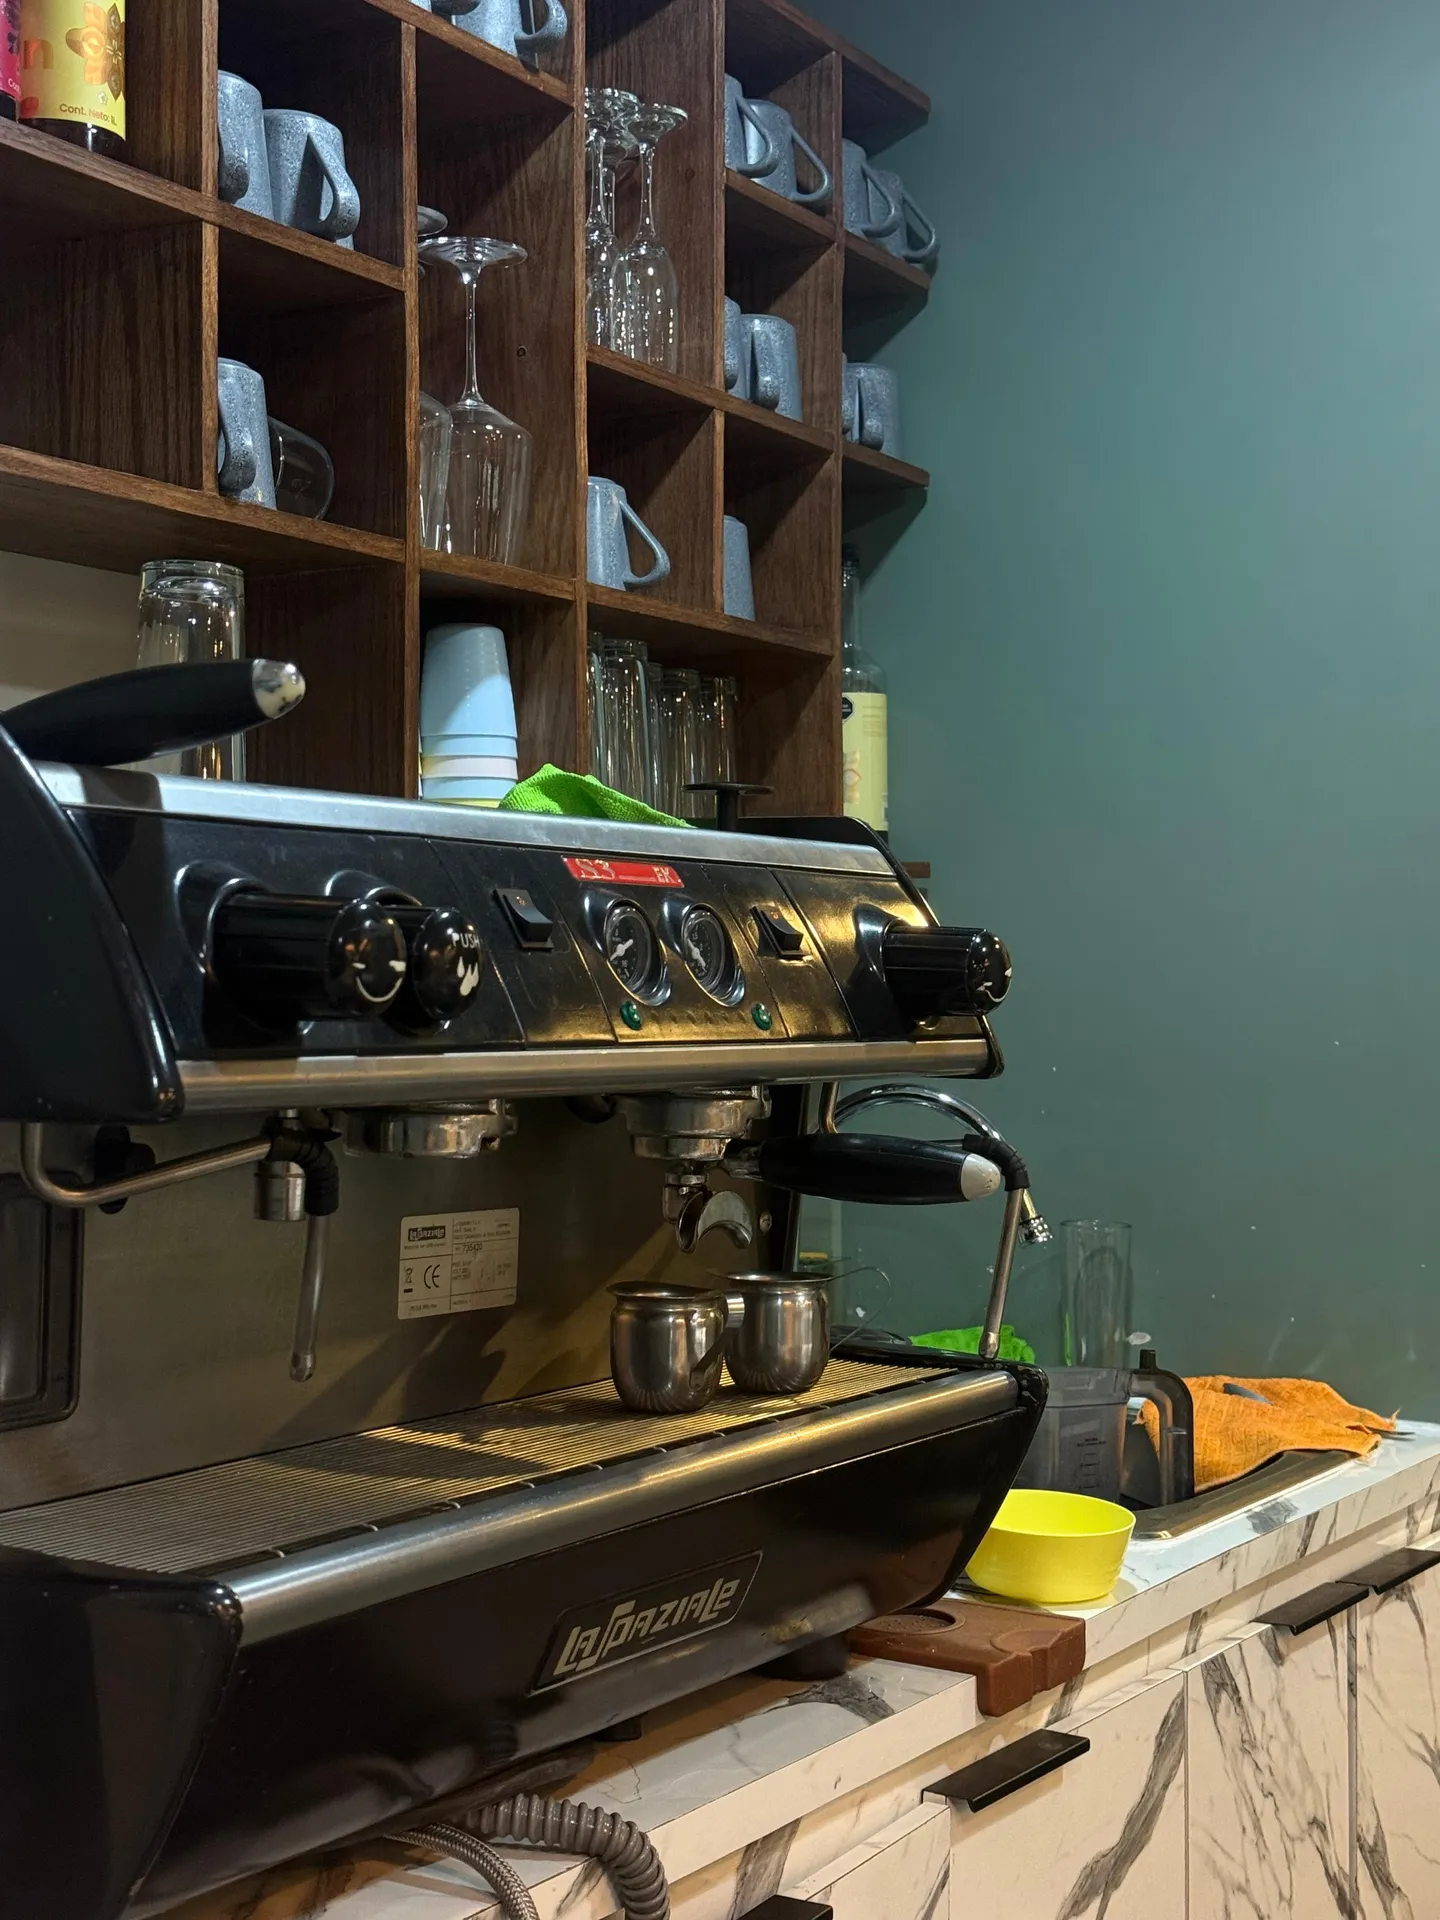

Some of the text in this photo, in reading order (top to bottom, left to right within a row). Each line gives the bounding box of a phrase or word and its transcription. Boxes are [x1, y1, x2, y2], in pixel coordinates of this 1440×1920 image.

[59, 103, 87, 116] Cont.
[88, 108, 110, 122] Neto:
[575, 858, 615, 880] S3
[451, 932, 481, 949] PUSH
